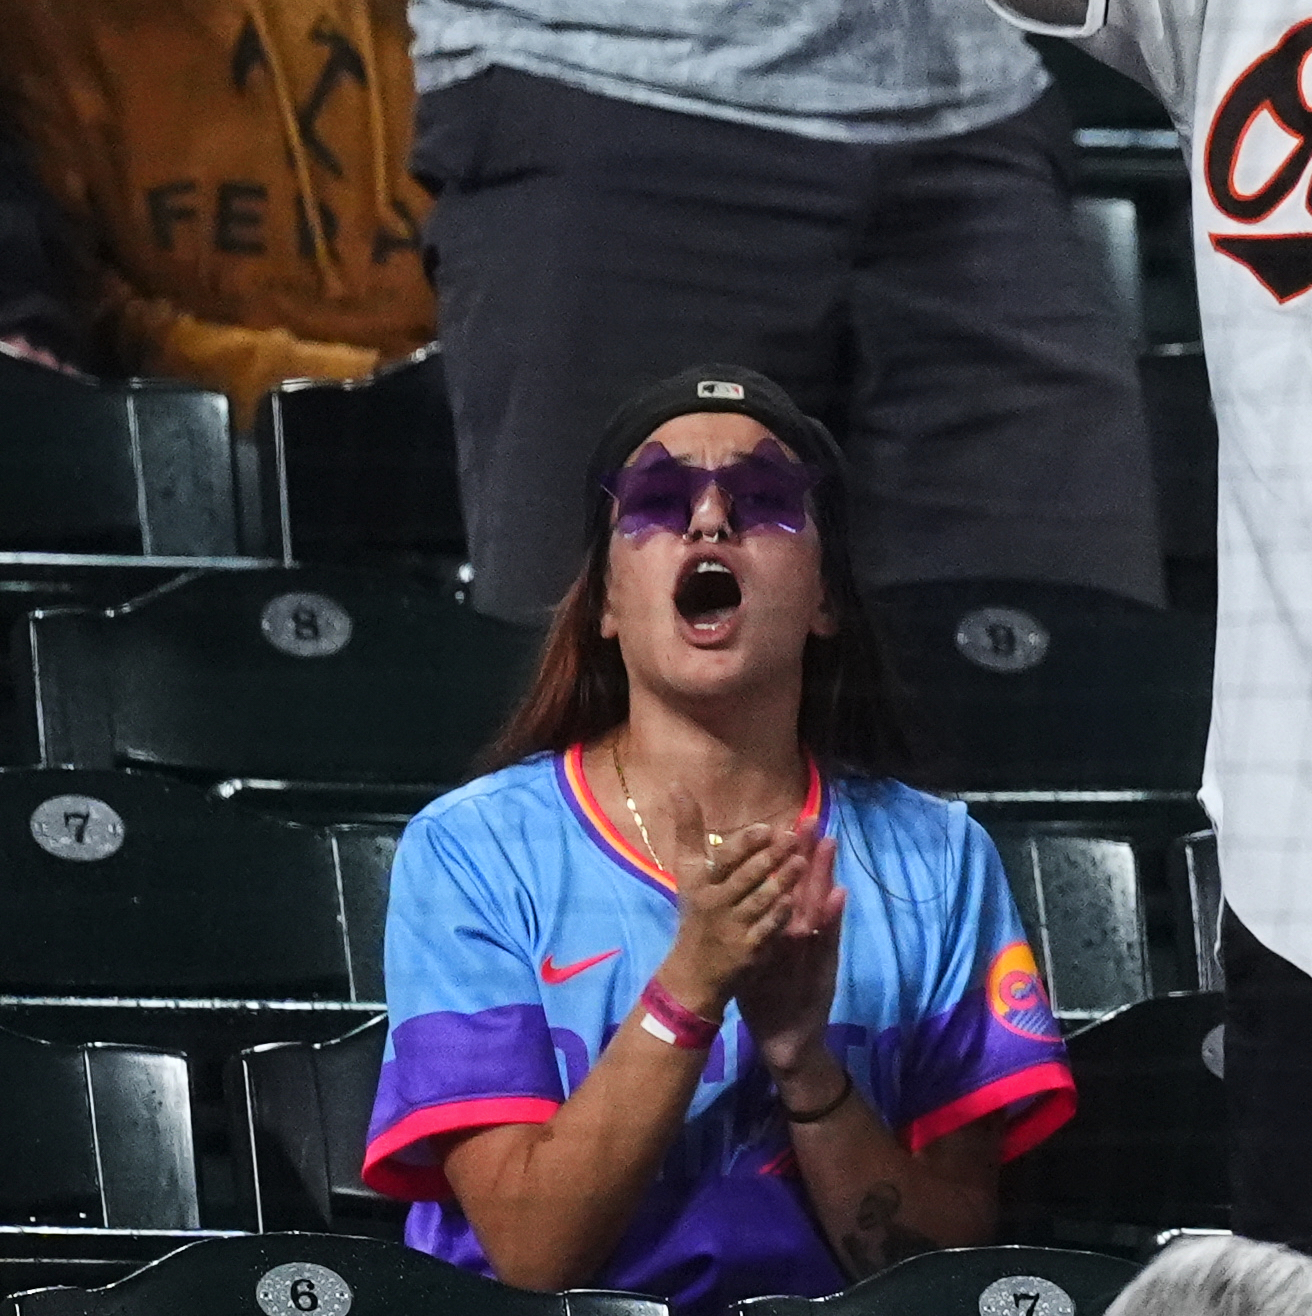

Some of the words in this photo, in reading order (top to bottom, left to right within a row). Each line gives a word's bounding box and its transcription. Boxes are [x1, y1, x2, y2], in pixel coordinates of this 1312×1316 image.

[292, 605, 319, 641] 8
[64, 811, 89, 844] 7
[290, 1279, 318, 1312] 6
[1013, 1293, 1040, 1316] 7
